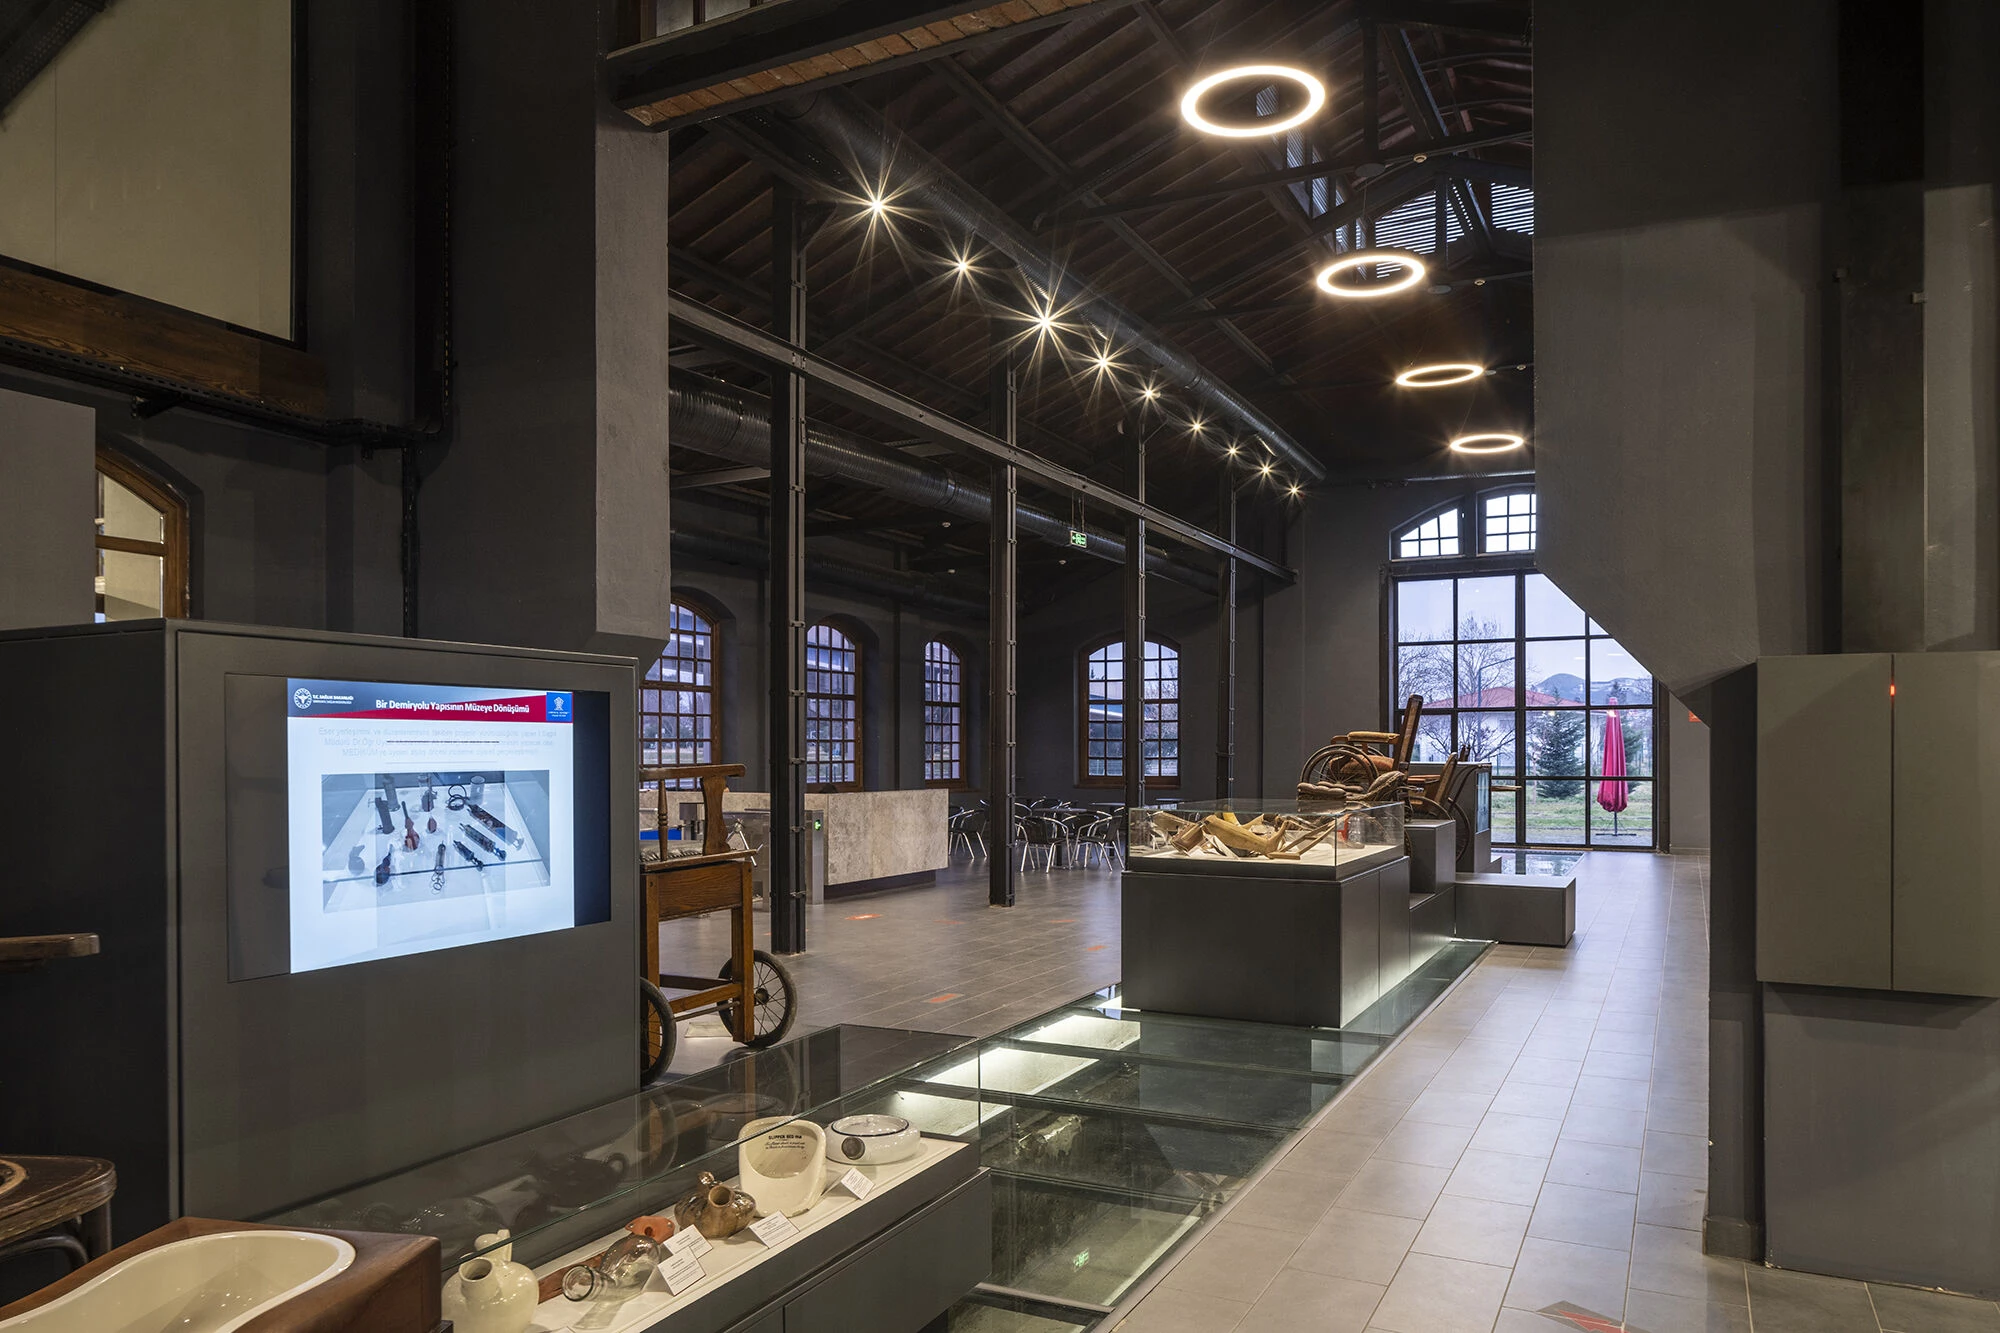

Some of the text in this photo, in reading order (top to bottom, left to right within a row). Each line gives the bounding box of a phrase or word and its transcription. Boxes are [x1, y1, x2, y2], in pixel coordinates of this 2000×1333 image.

[375, 699, 530, 715] Bir Demiryolu Yapısının Müzeye Dönüşümü
